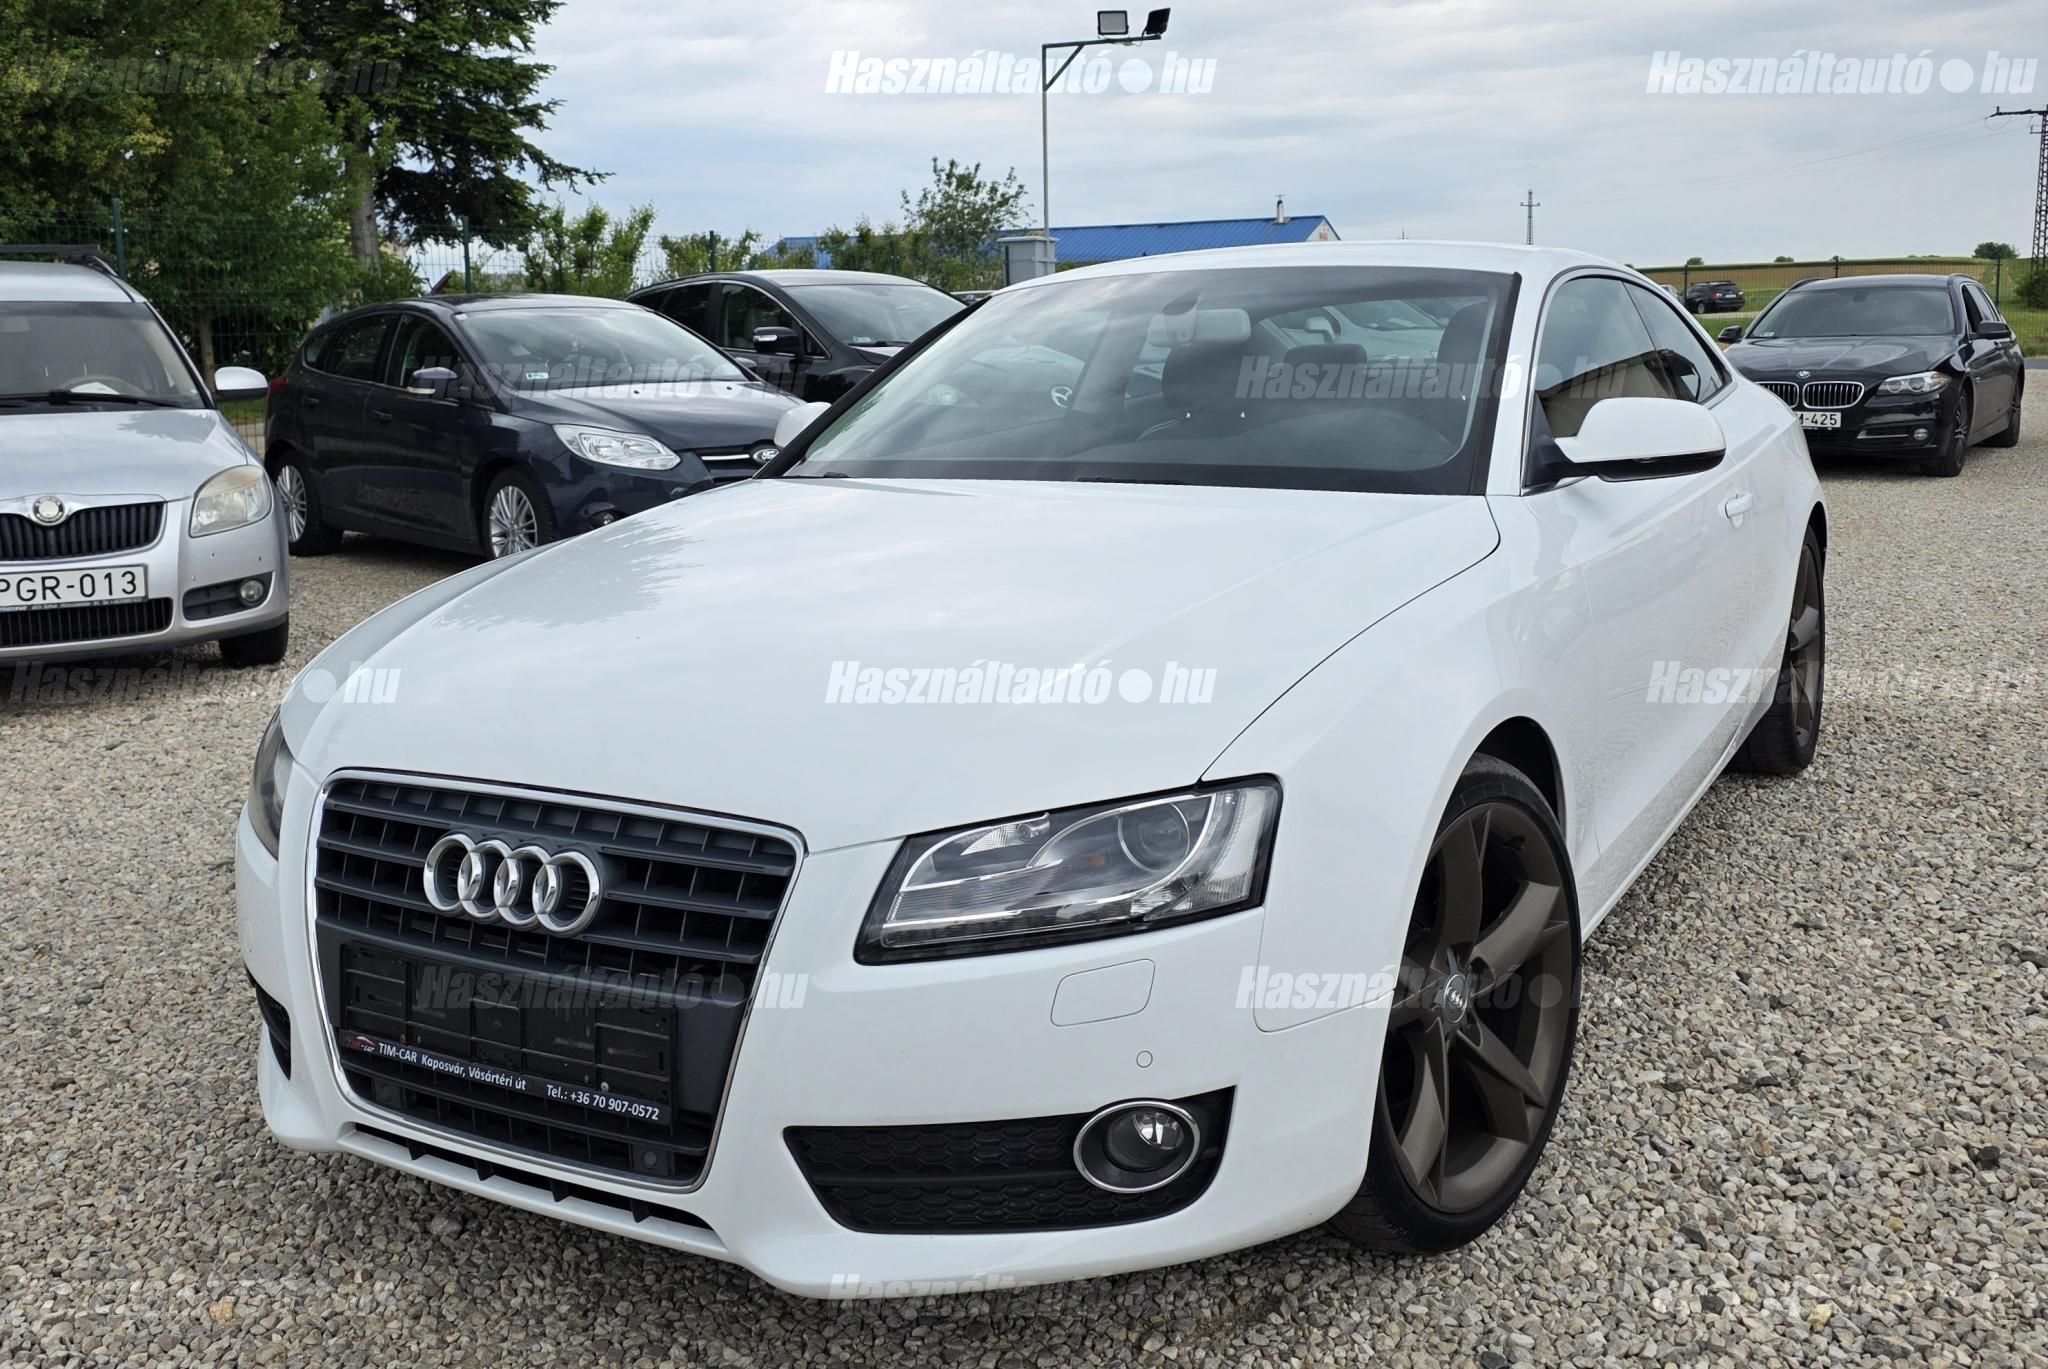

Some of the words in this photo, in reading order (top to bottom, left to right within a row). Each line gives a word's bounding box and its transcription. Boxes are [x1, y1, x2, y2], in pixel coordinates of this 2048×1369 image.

[0, 570, 137, 602] PGR-013
[379, 1042, 417, 1063] TIM-CAR
[421, 1054, 466, 1077] Kaposvár,
[468, 1066, 513, 1087] Vásártéri
[515, 1077, 527, 1090] út
[547, 1084, 568, 1099] Tel.:
[570, 1091, 590, 1105] +36
[592, 1094, 606, 1108] 70
[607, 1098, 660, 1120] 907-0572
